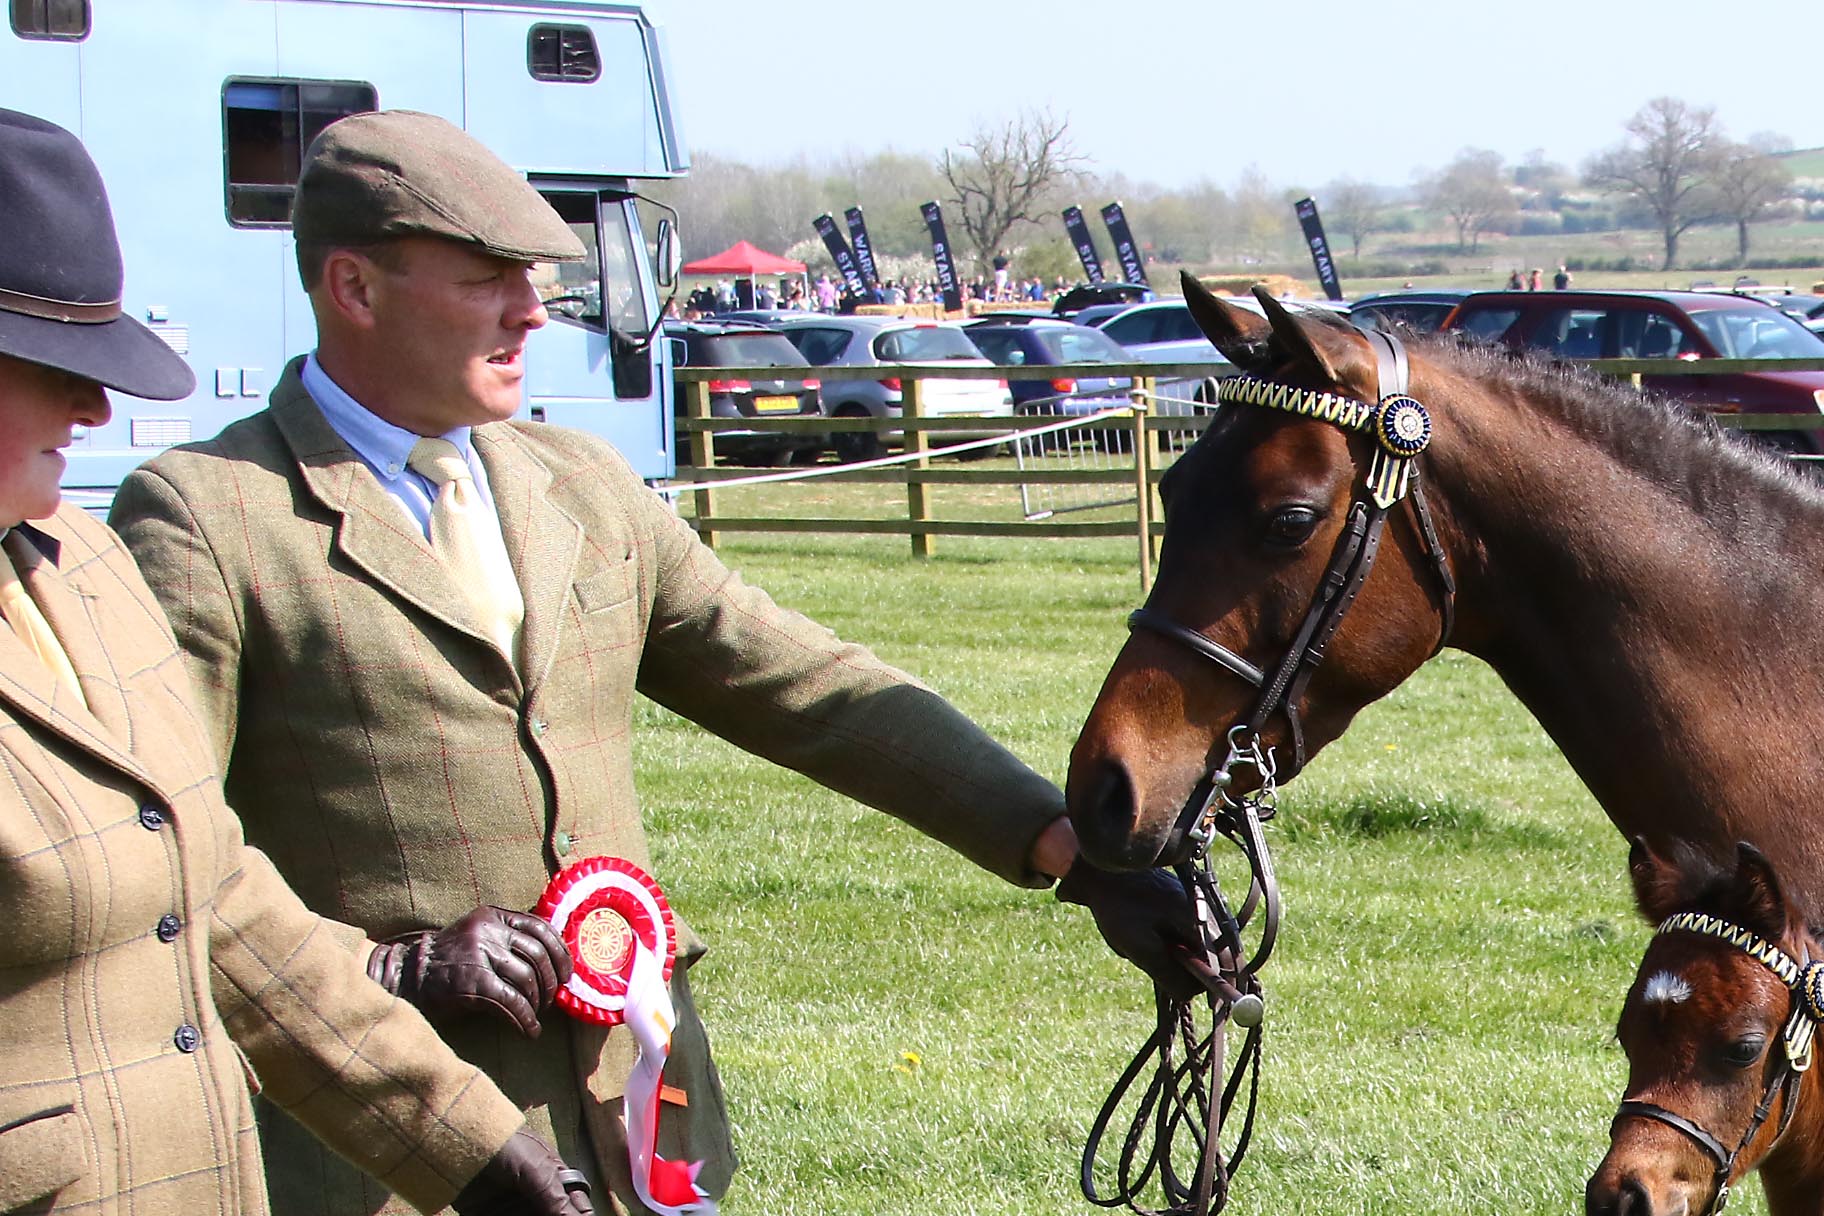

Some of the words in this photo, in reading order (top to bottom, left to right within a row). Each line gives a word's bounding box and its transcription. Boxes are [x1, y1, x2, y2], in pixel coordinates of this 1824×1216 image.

[837, 251, 867, 297] START
[934, 242, 953, 291] START
[1080, 244, 1101, 282] STAR
[1120, 242, 1141, 283] STAR
[1310, 237, 1334, 284] START
